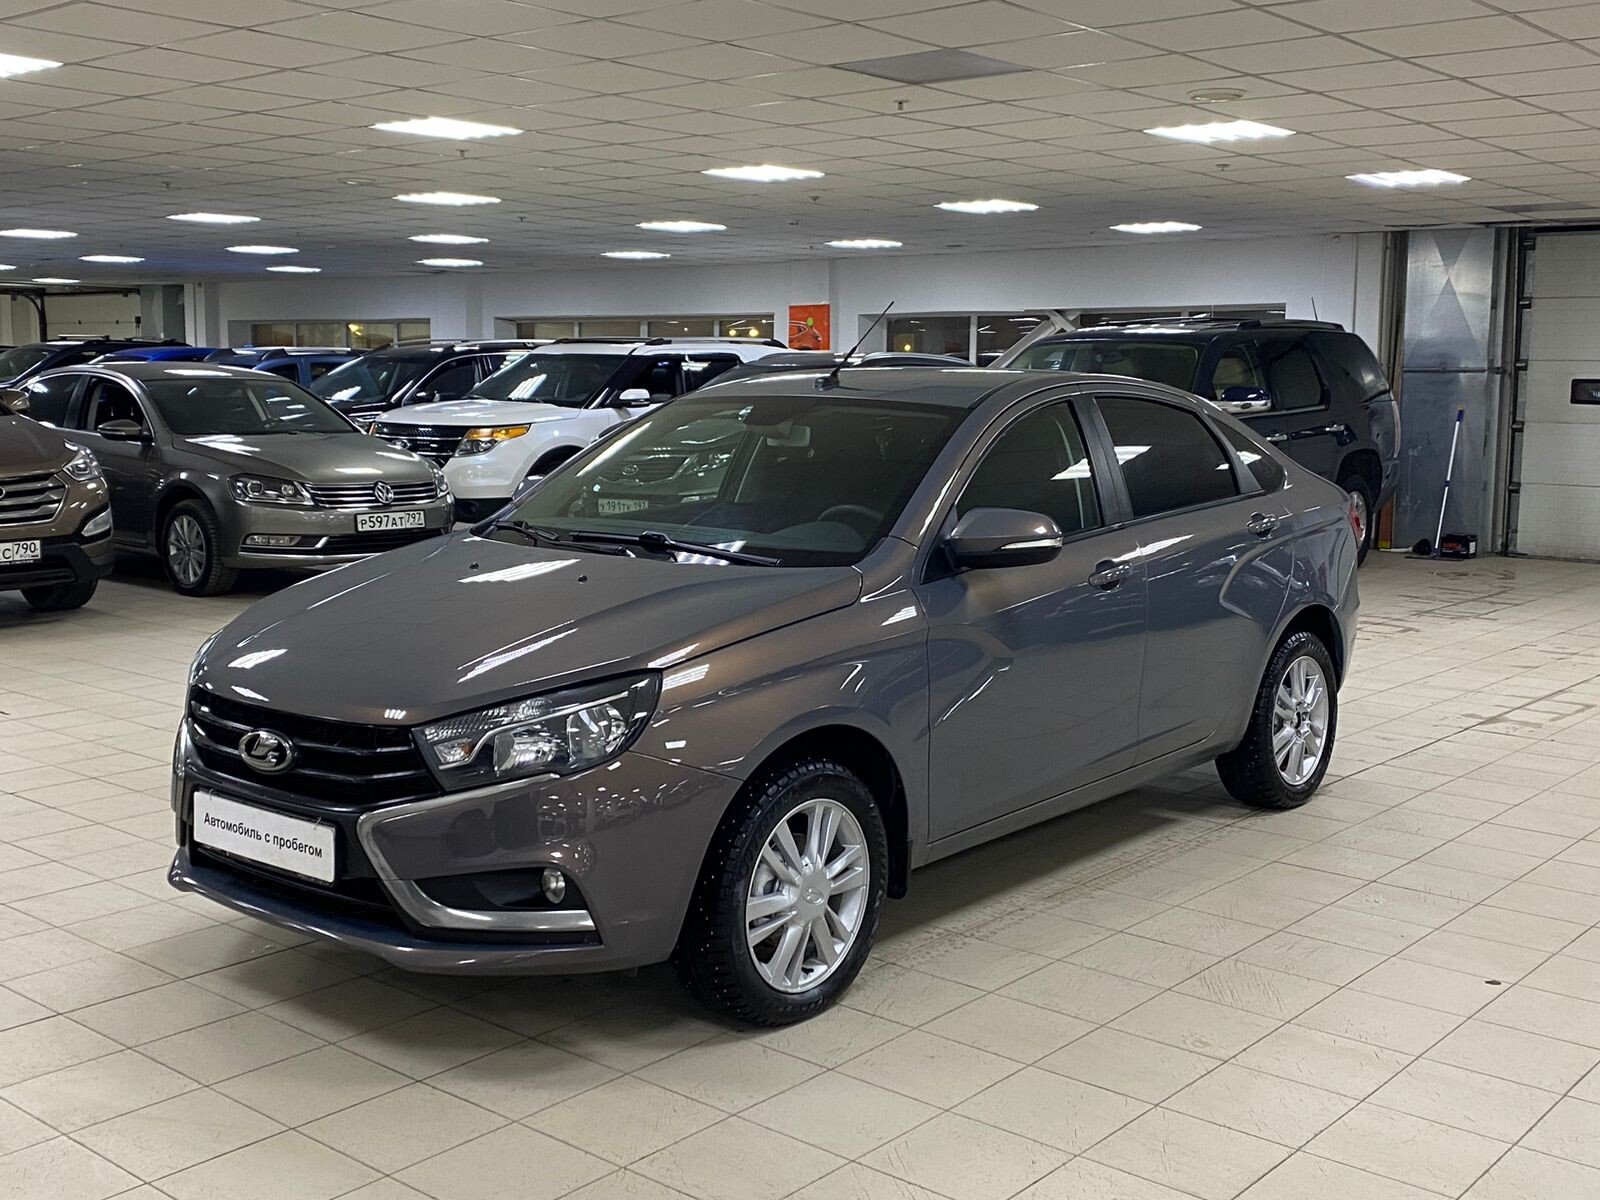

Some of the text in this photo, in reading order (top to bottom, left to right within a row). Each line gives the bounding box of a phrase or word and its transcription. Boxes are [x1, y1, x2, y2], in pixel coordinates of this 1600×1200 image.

[406, 512, 421, 523] 797
[14, 542, 36, 554] 790
[203, 812, 323, 858] Автомобиль с пробегом
